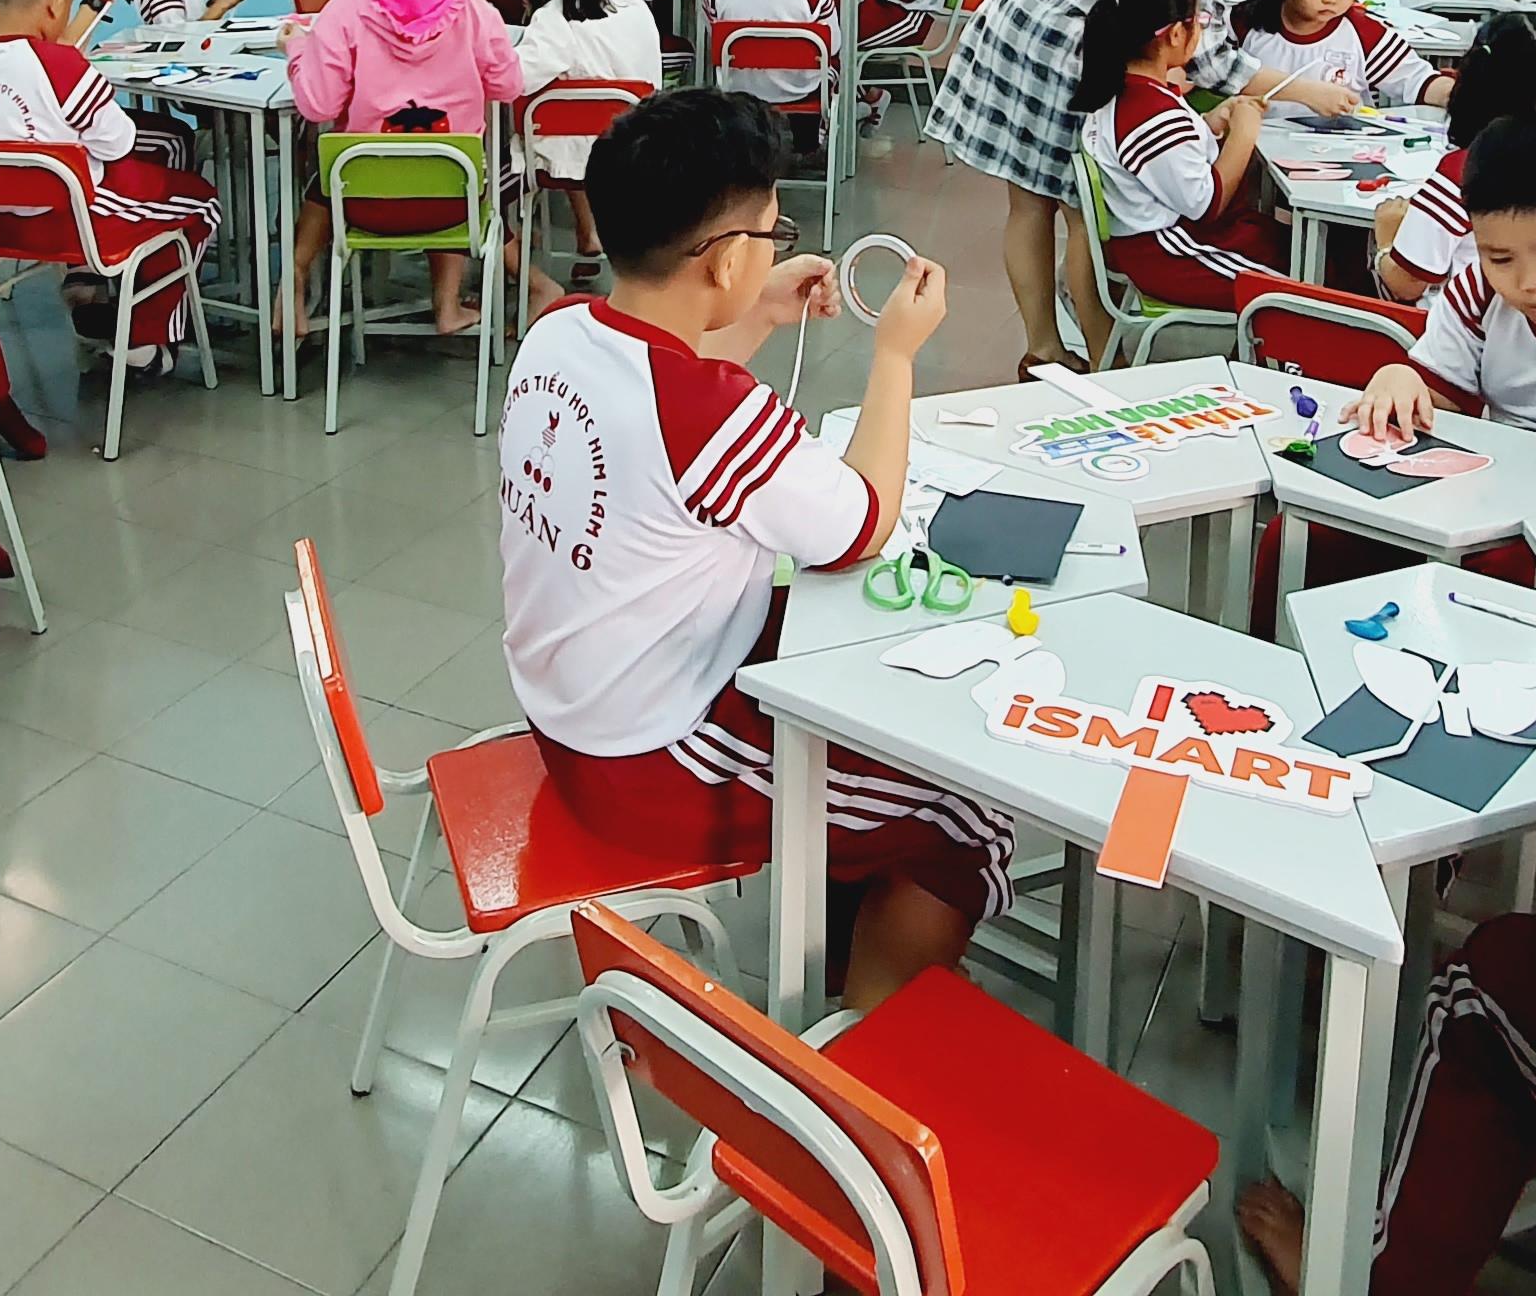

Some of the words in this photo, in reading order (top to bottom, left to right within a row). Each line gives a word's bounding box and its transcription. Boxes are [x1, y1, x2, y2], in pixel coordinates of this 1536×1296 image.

[1105, 393, 1222, 423] KHOA
[588, 437, 607, 480] HIM
[501, 474, 562, 553] UẬN
[571, 543, 594, 571] 6
[585, 490, 608, 538] LAM
[1146, 684, 1176, 723] I
[1002, 694, 1352, 800] iSMART
